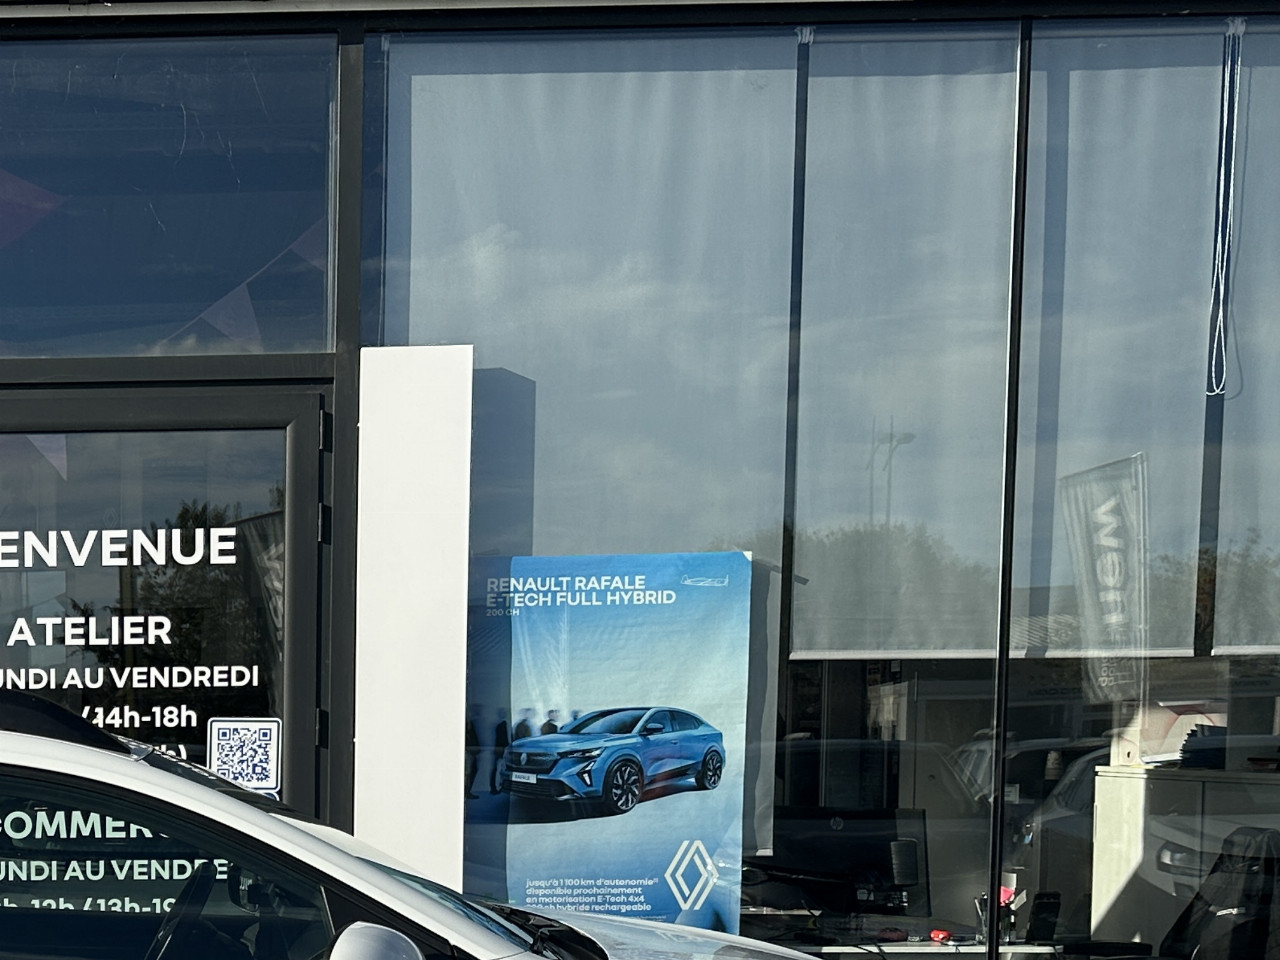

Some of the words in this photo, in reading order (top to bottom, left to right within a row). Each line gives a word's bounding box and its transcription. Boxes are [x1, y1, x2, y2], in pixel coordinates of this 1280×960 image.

[487, 577, 571, 592] RENAULT
[574, 575, 646, 591] RAFALE
[486, 592, 551, 608] E-TECH
[556, 592, 602, 606] FULL
[607, 590, 677, 606] HYBRID
[7, 616, 172, 647] ATELIER
[62, 668, 105, 689] AU
[112, 665, 259, 689] VENDREDI
[64, 860, 105, 881] AU
